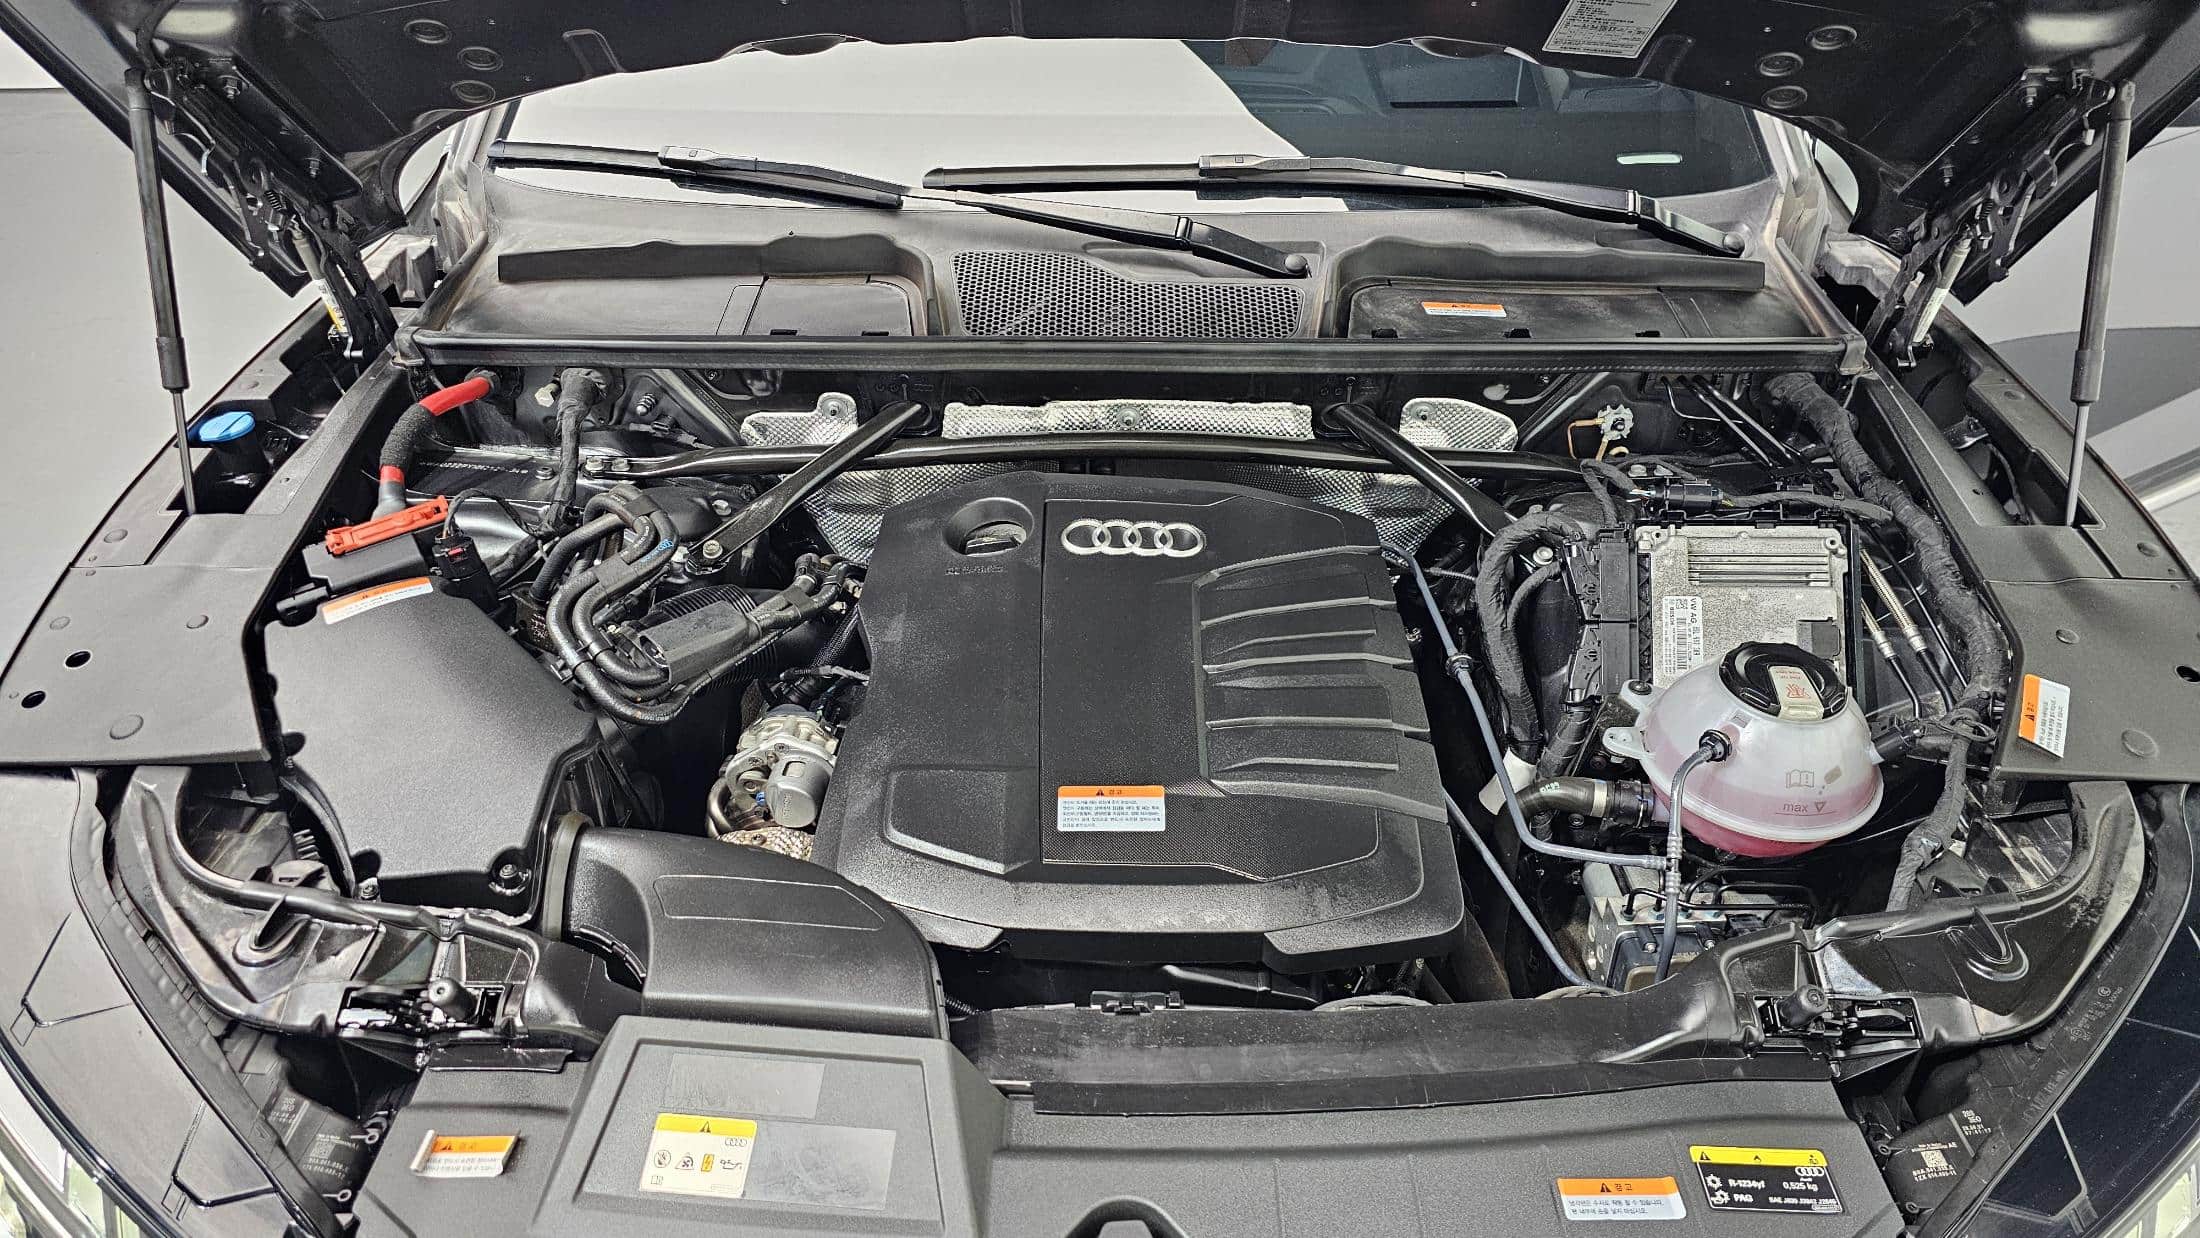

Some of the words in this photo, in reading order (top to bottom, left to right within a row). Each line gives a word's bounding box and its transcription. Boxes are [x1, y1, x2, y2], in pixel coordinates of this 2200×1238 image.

[1783, 803, 1808, 813] max
[1782, 1181, 1806, 1191] 0,525
[1807, 1182, 1819, 1192] kg
